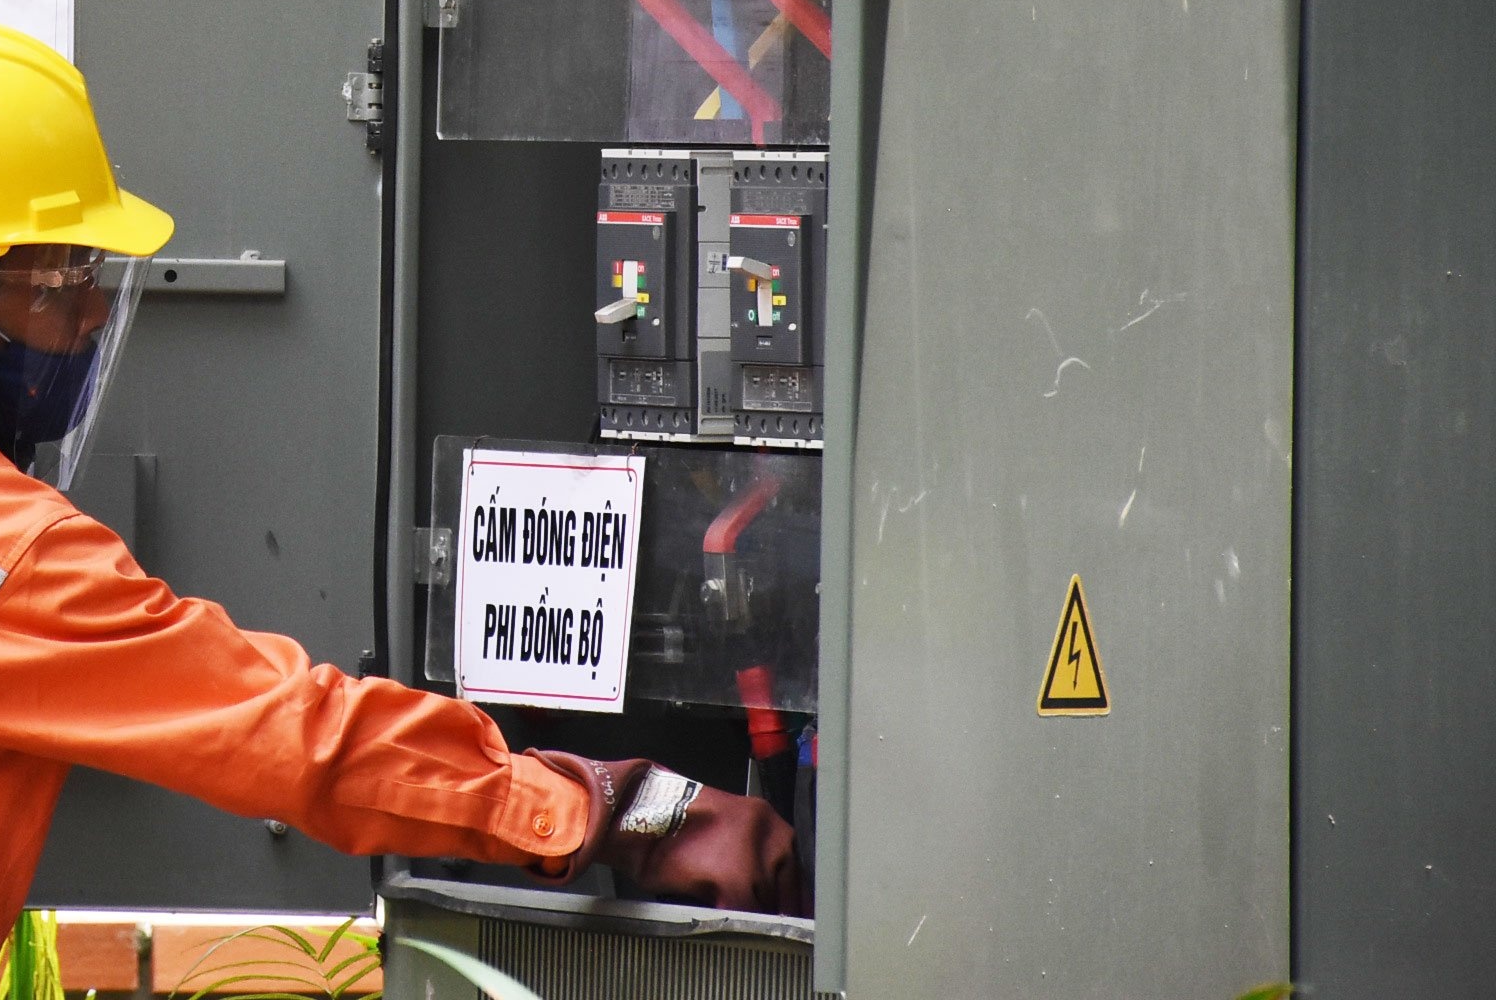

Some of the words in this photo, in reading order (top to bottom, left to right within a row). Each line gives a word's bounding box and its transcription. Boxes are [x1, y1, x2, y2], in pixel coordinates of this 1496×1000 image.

[599, 213, 608, 222] ABB
[730, 216, 740, 224] ABB
[772, 269, 780, 277] on
[472, 486, 516, 564] CẤM
[522, 497, 576, 567] ĐÓNG
[580, 500, 627, 582] ĐIỆN
[482, 603, 516, 661] PHI
[520, 587, 573, 665] ĐỒNG
[577, 597, 605, 680] BỘ
